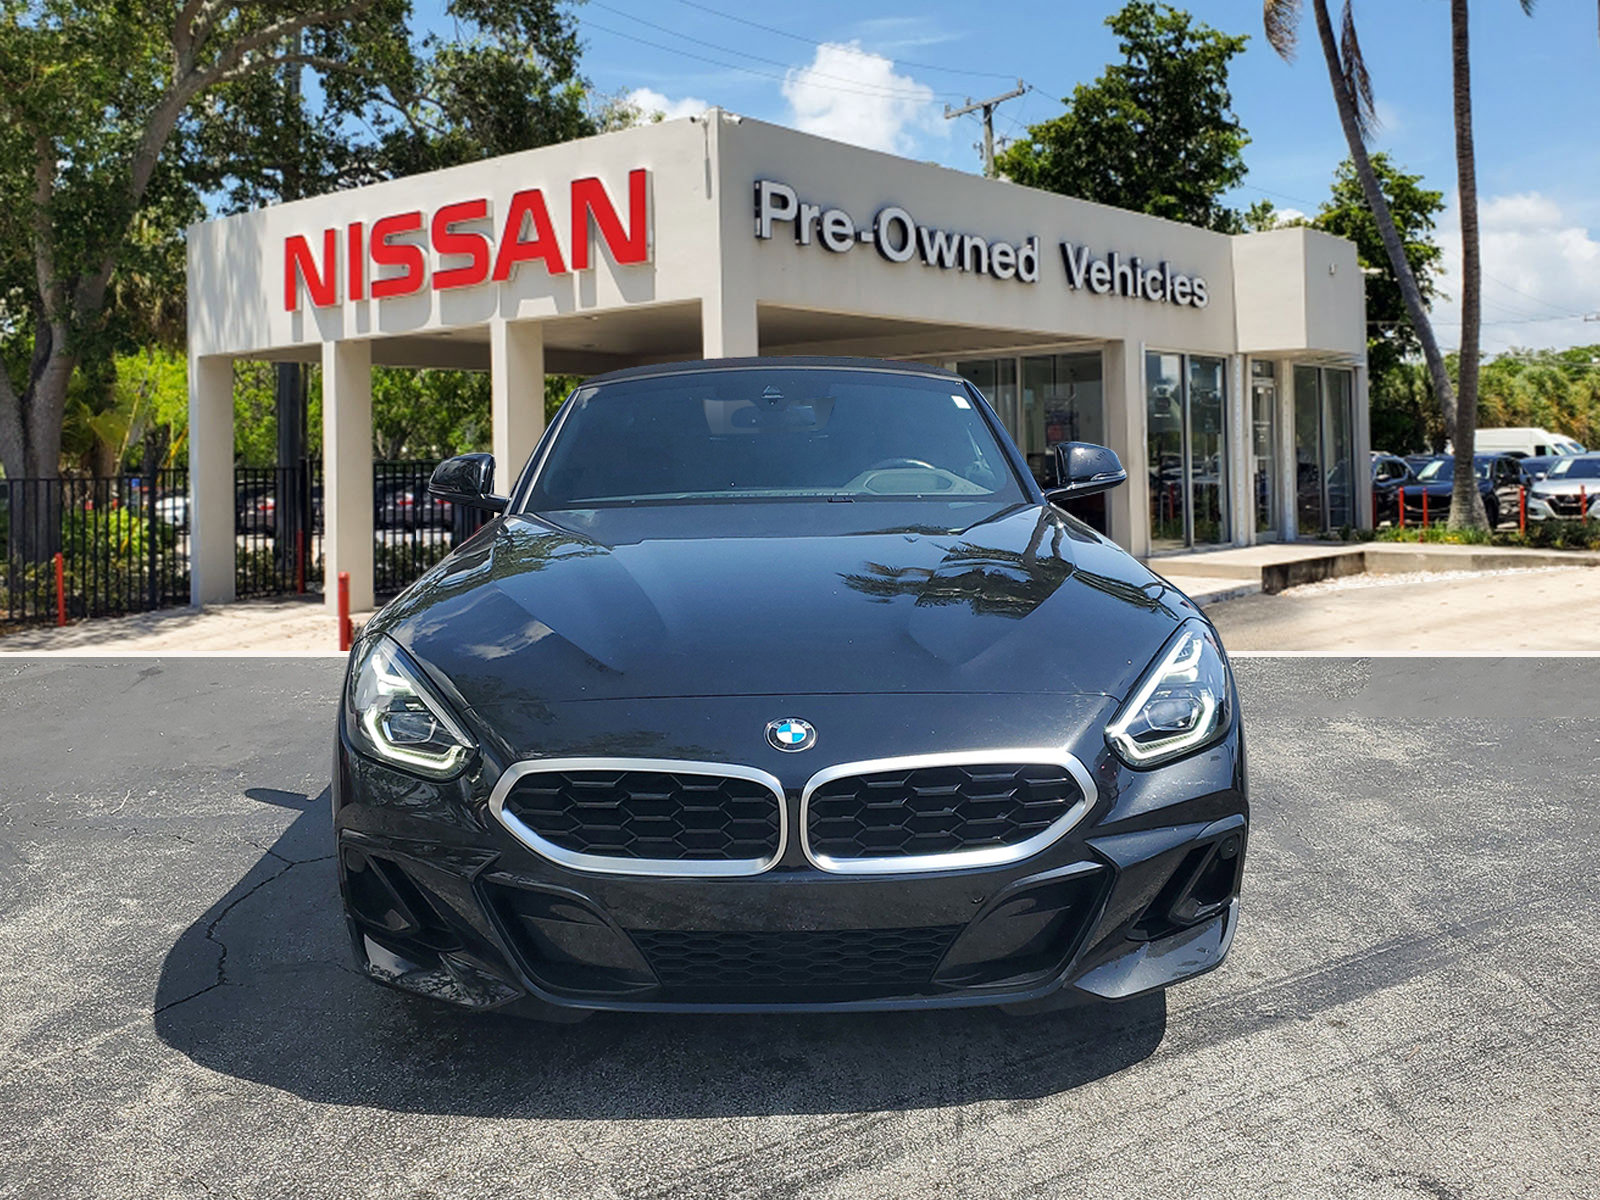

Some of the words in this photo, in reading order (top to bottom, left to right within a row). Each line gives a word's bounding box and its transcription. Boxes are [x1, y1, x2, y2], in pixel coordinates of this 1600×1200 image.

[284, 168, 647, 312] NISSAN
[754, 179, 1040, 283] Pre-Owned
[1059, 242, 1209, 308] Vehicles
